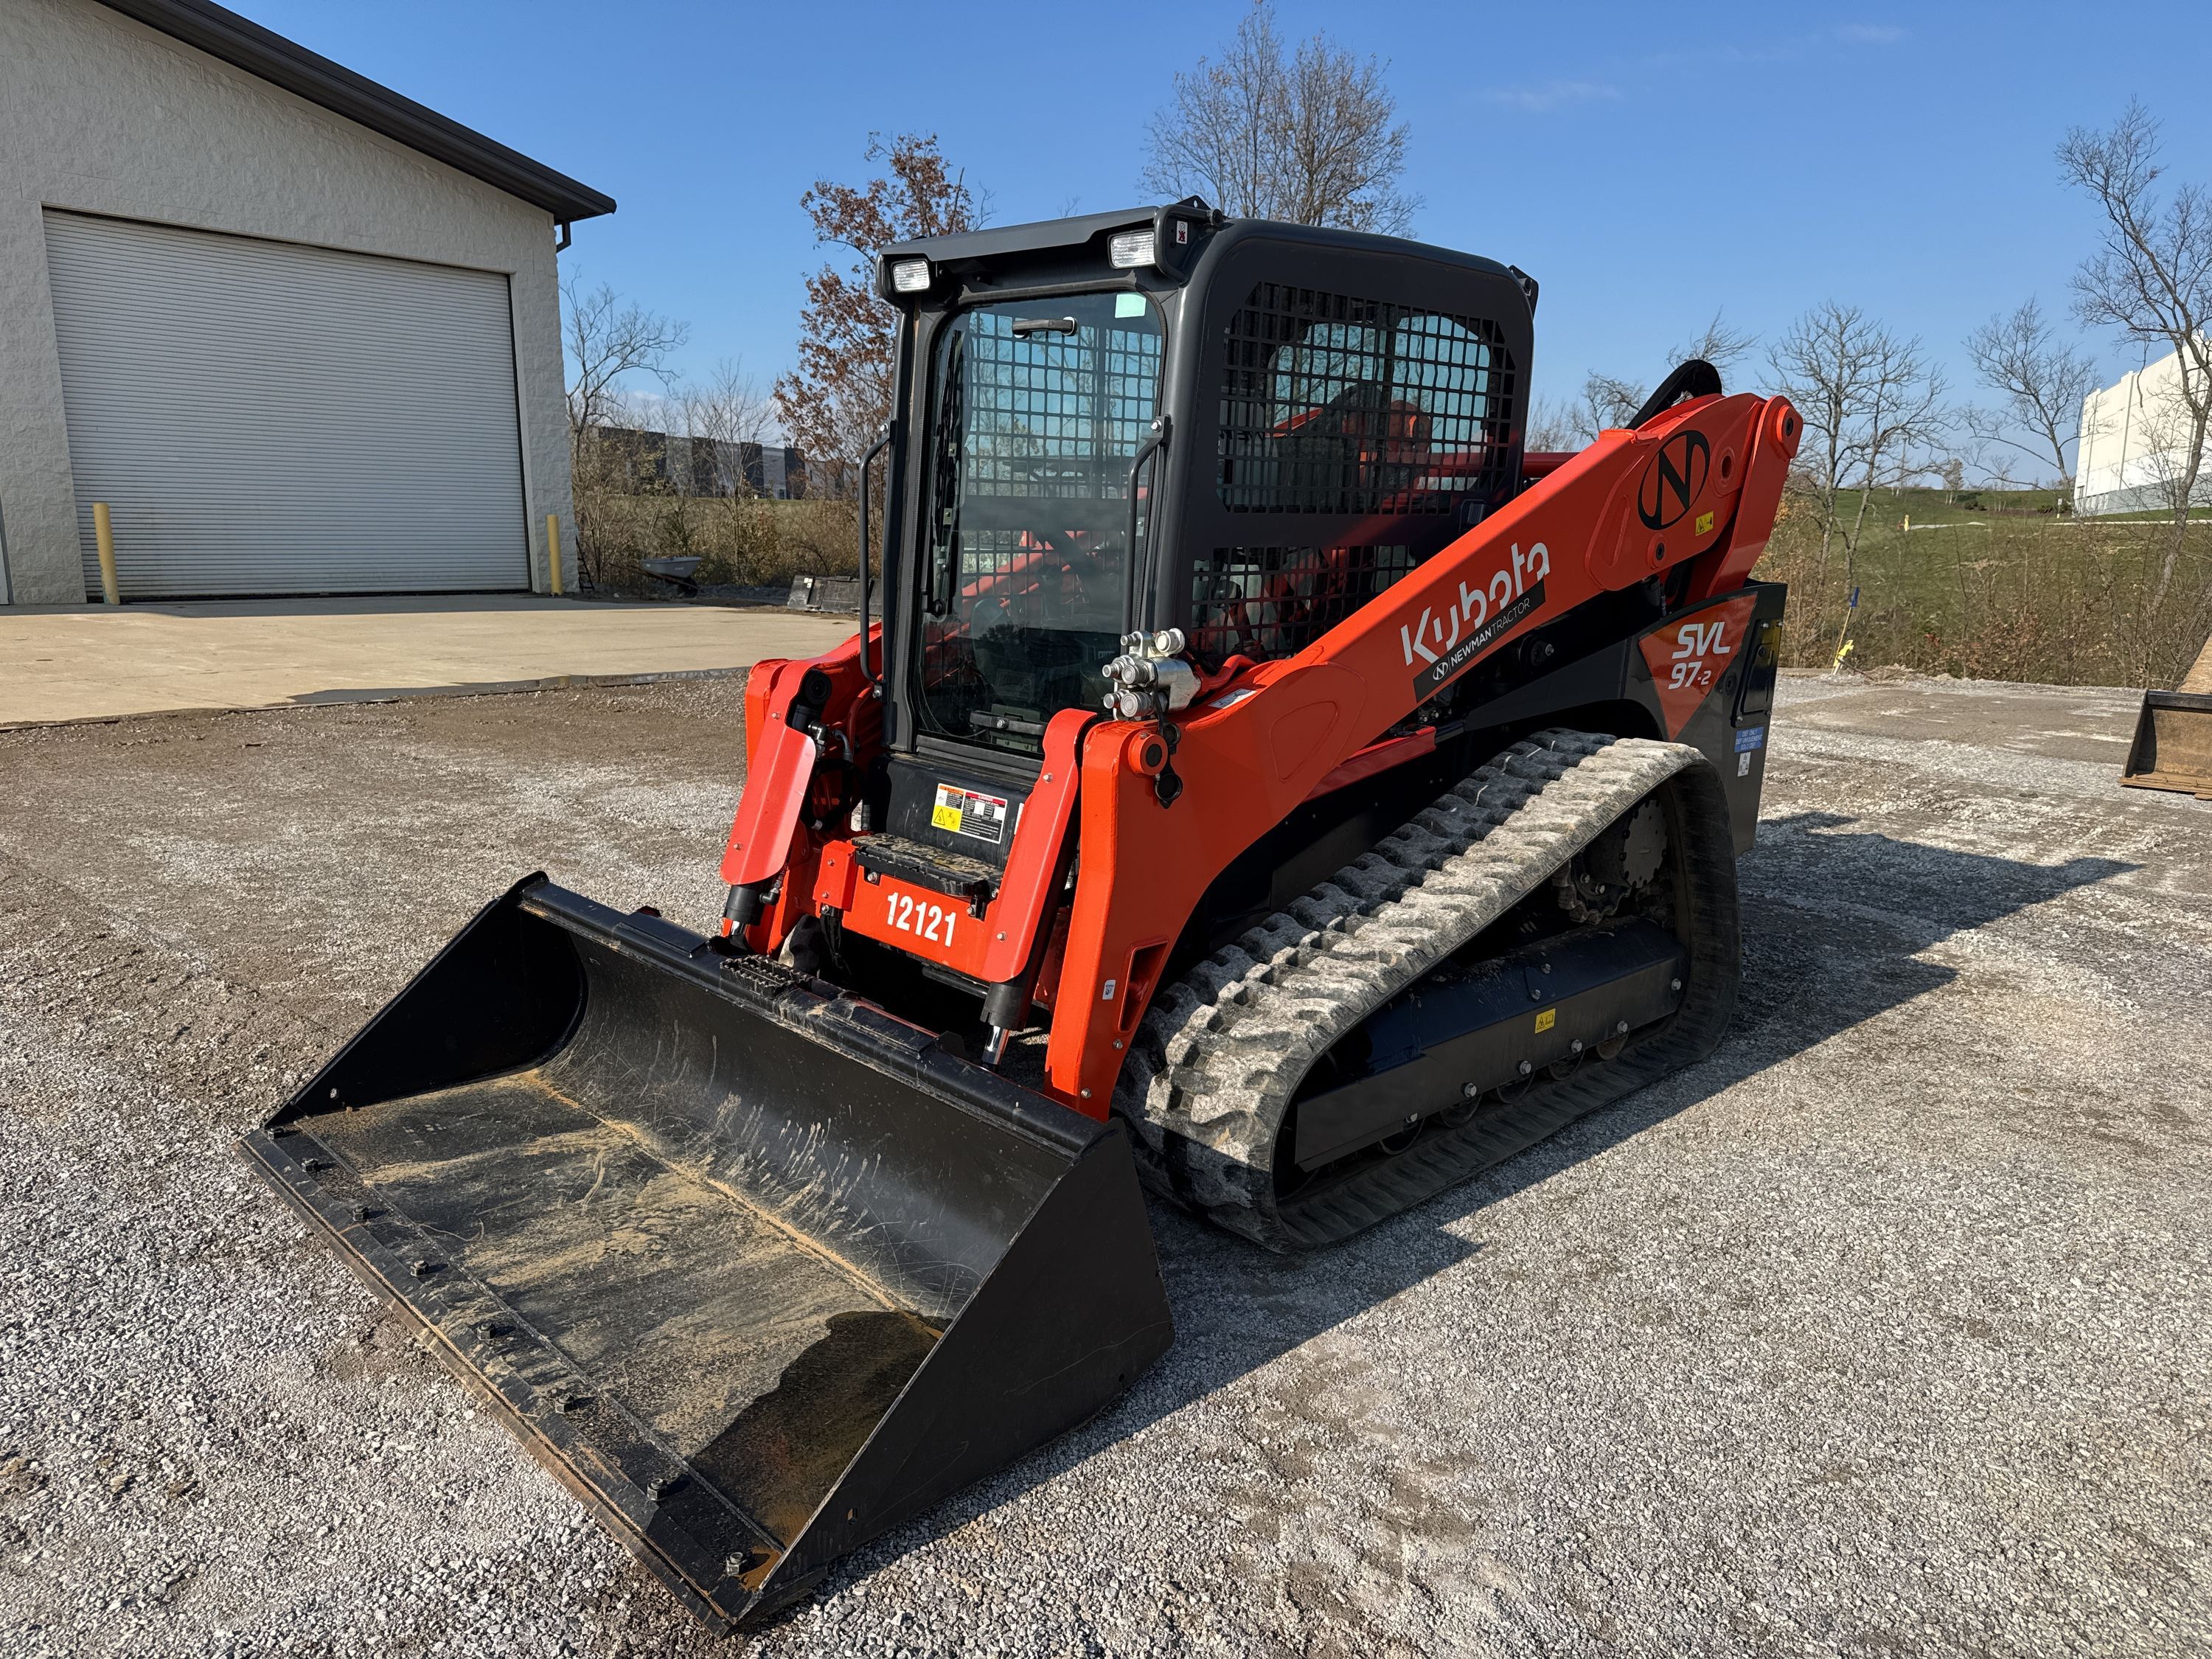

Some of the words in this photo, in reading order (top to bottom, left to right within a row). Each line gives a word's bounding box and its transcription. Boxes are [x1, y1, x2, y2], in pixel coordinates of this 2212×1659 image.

[1400, 542, 1551, 667] Kubota
[1672, 622, 1731, 659] SVL
[887, 891, 956, 947] 12121
